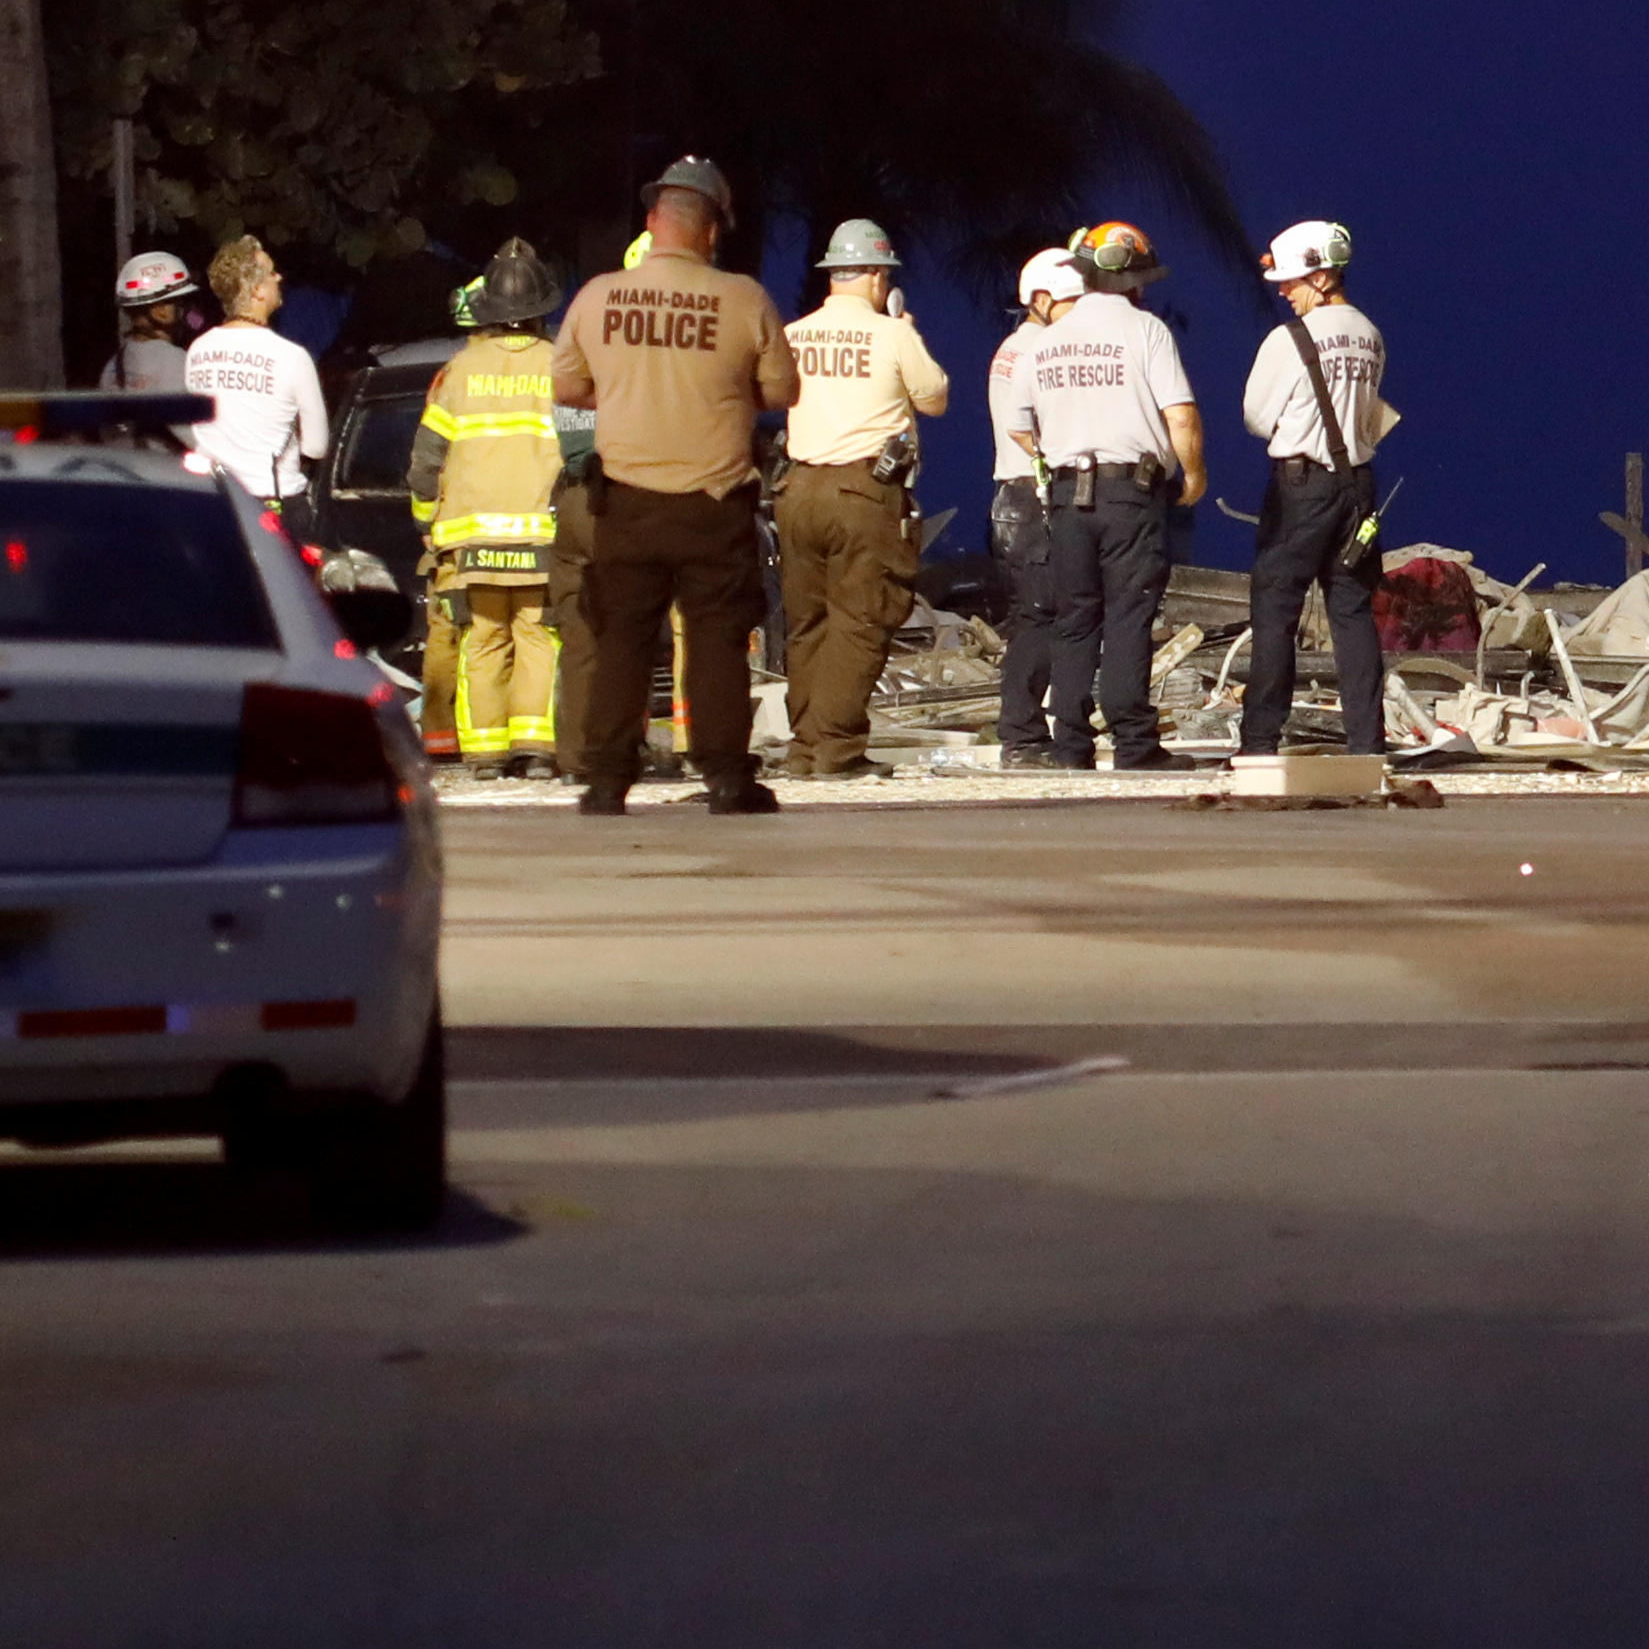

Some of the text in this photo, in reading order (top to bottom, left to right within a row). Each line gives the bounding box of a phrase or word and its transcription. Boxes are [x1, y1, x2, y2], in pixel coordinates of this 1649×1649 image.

[606, 288, 720, 312] MIAMI-DADE
[603, 309, 719, 351] POLICE
[789, 329, 872, 346] MIAMI-DADE
[190, 351, 275, 372] MIAMI-DADE
[1035, 343, 1124, 365] MIAMI-DADE
[189, 369, 274, 394] FIRE RESCUE
[1036, 366, 1064, 391] FIRE
[1068, 364, 1124, 387] RESCUE
[1320, 356, 1342, 383] IRE
[467, 374, 552, 398] MIAMI-DAD
[477, 549, 537, 568] SANTANA
